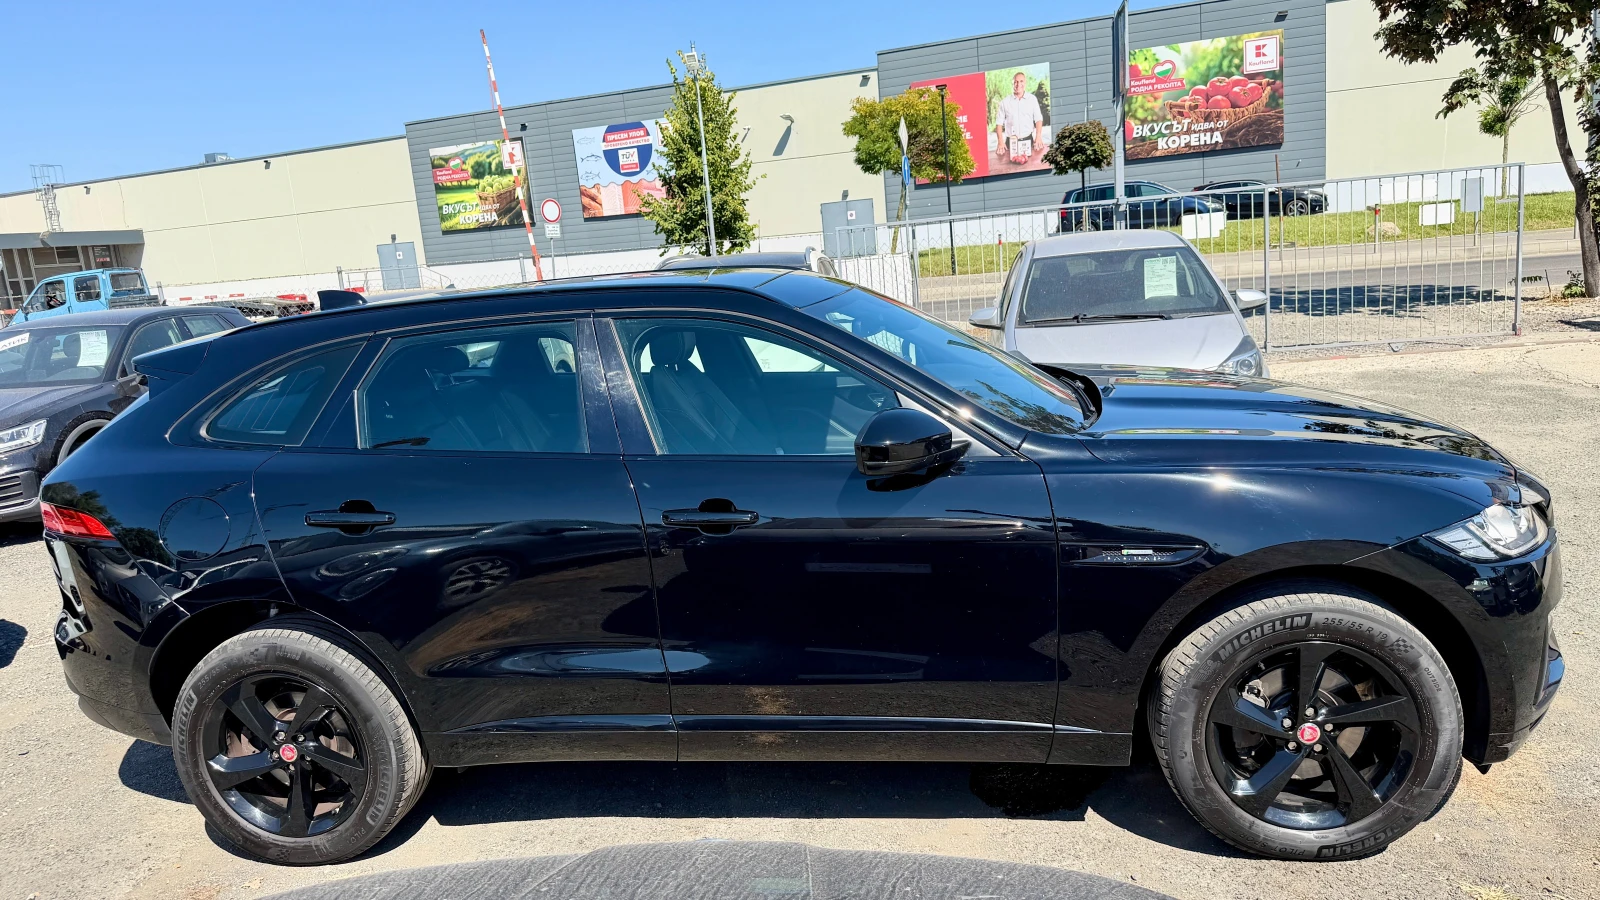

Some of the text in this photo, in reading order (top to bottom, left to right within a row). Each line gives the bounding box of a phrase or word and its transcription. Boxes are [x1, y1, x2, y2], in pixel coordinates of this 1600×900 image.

[1130, 78, 1156, 86] Kaufland
[1130, 81, 1183, 93] РОДНА РЕКОЛТА
[607, 132, 629, 141] ПРЕСЕН
[1133, 119, 1229, 138] ВКУСЪТ ИДВА ОТ
[1157, 131, 1224, 150] КОРЕНА
[442, 202, 478, 215] ВКУСЪТ
[459, 212, 499, 224] КОРЕНА
[1321, 617, 1389, 640] 255/55 R 19
[1219, 615, 1307, 661] MICHELIN
[1424, 667, 1443, 692] OUTSIDE
[1320, 815, 1408, 858] MICHELIN
[1270, 845, 1306, 856] PILOT
